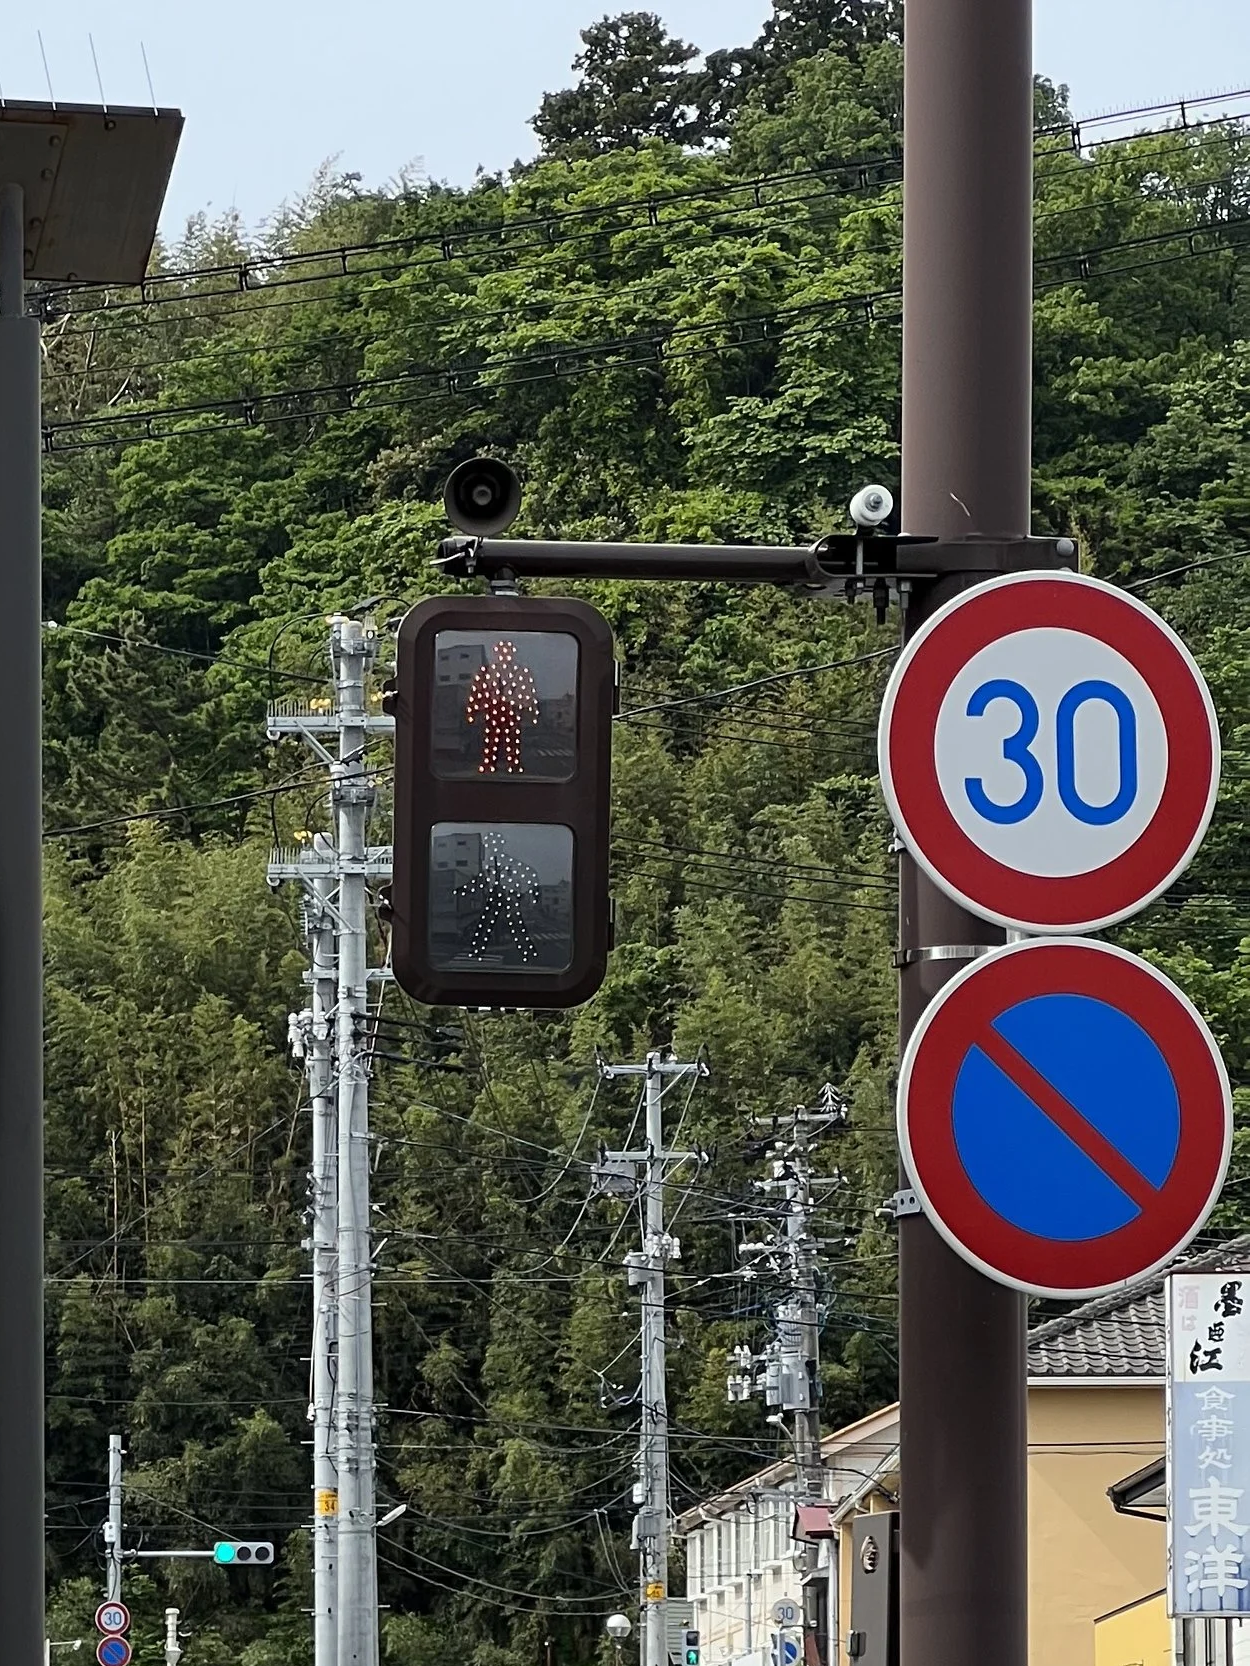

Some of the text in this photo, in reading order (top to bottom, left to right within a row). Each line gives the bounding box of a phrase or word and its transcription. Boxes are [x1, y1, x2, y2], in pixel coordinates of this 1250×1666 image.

[964, 678, 1137, 826] 30
[1193, 1385, 1236, 1470] 食事処
[1183, 1476, 1250, 1598] 東洋
[104, 1611, 122, 1626] 30
[777, 1606, 793, 1620] 30
